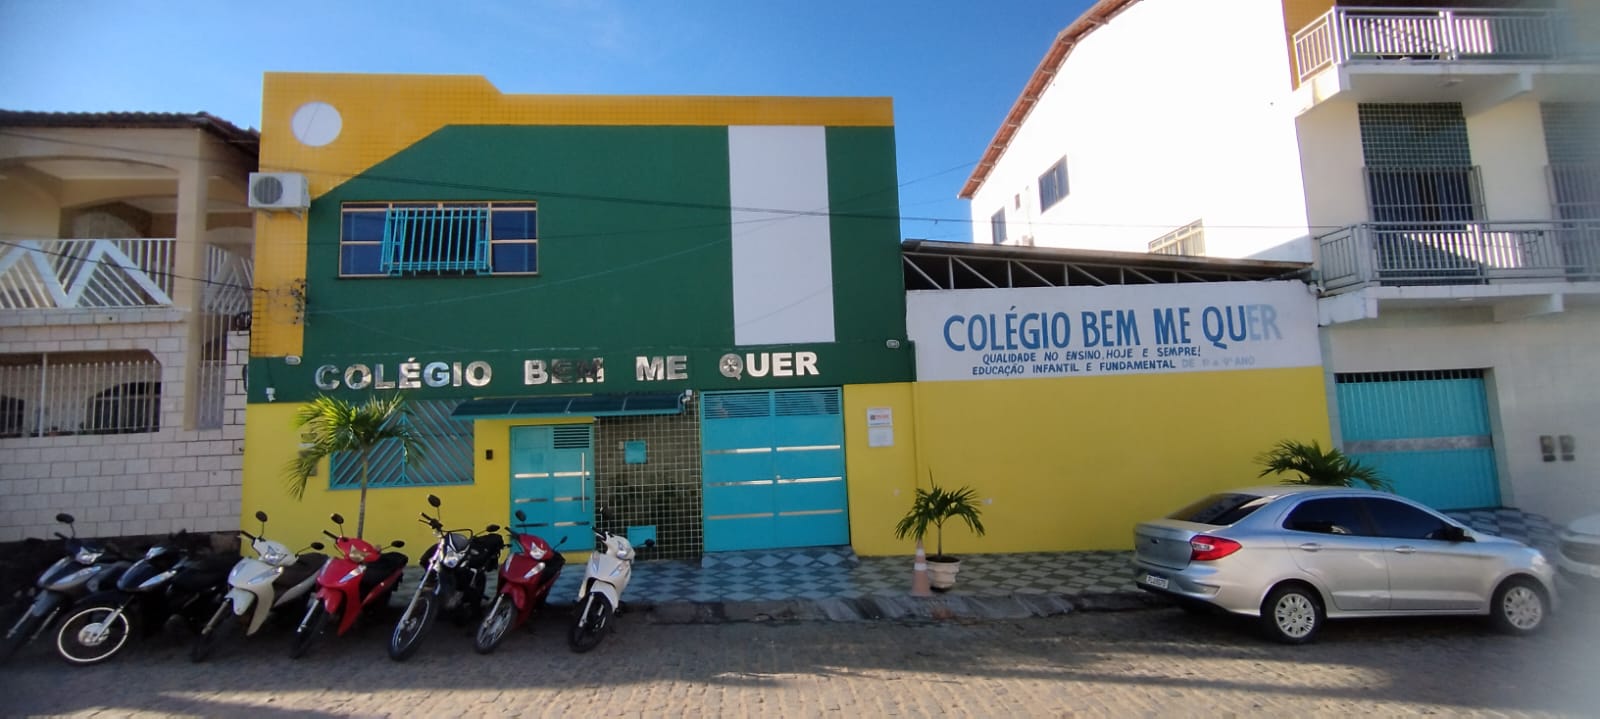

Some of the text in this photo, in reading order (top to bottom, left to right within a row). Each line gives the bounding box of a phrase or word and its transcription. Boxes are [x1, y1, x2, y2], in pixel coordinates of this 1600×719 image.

[943, 303, 1283, 351] COLÉGIO BEM ME QUER
[972, 362, 1025, 376] EDUCAÇÃO
[1032, 362, 1079, 374] INFANTIL
[1086, 362, 1092, 372] E
[1099, 359, 1176, 372] FUNDAMENTAL
[1182, 358, 1196, 368] DE
[1235, 354, 1256, 367] ANO
[982, 352, 1036, 365] QUALIDADE
[1044, 351, 1059, 361] NO
[1142, 348, 1149, 358] E
[1157, 345, 1200, 358] SEMPRE!
[314, 351, 819, 390] COLÉGIO BEM ME QUER
